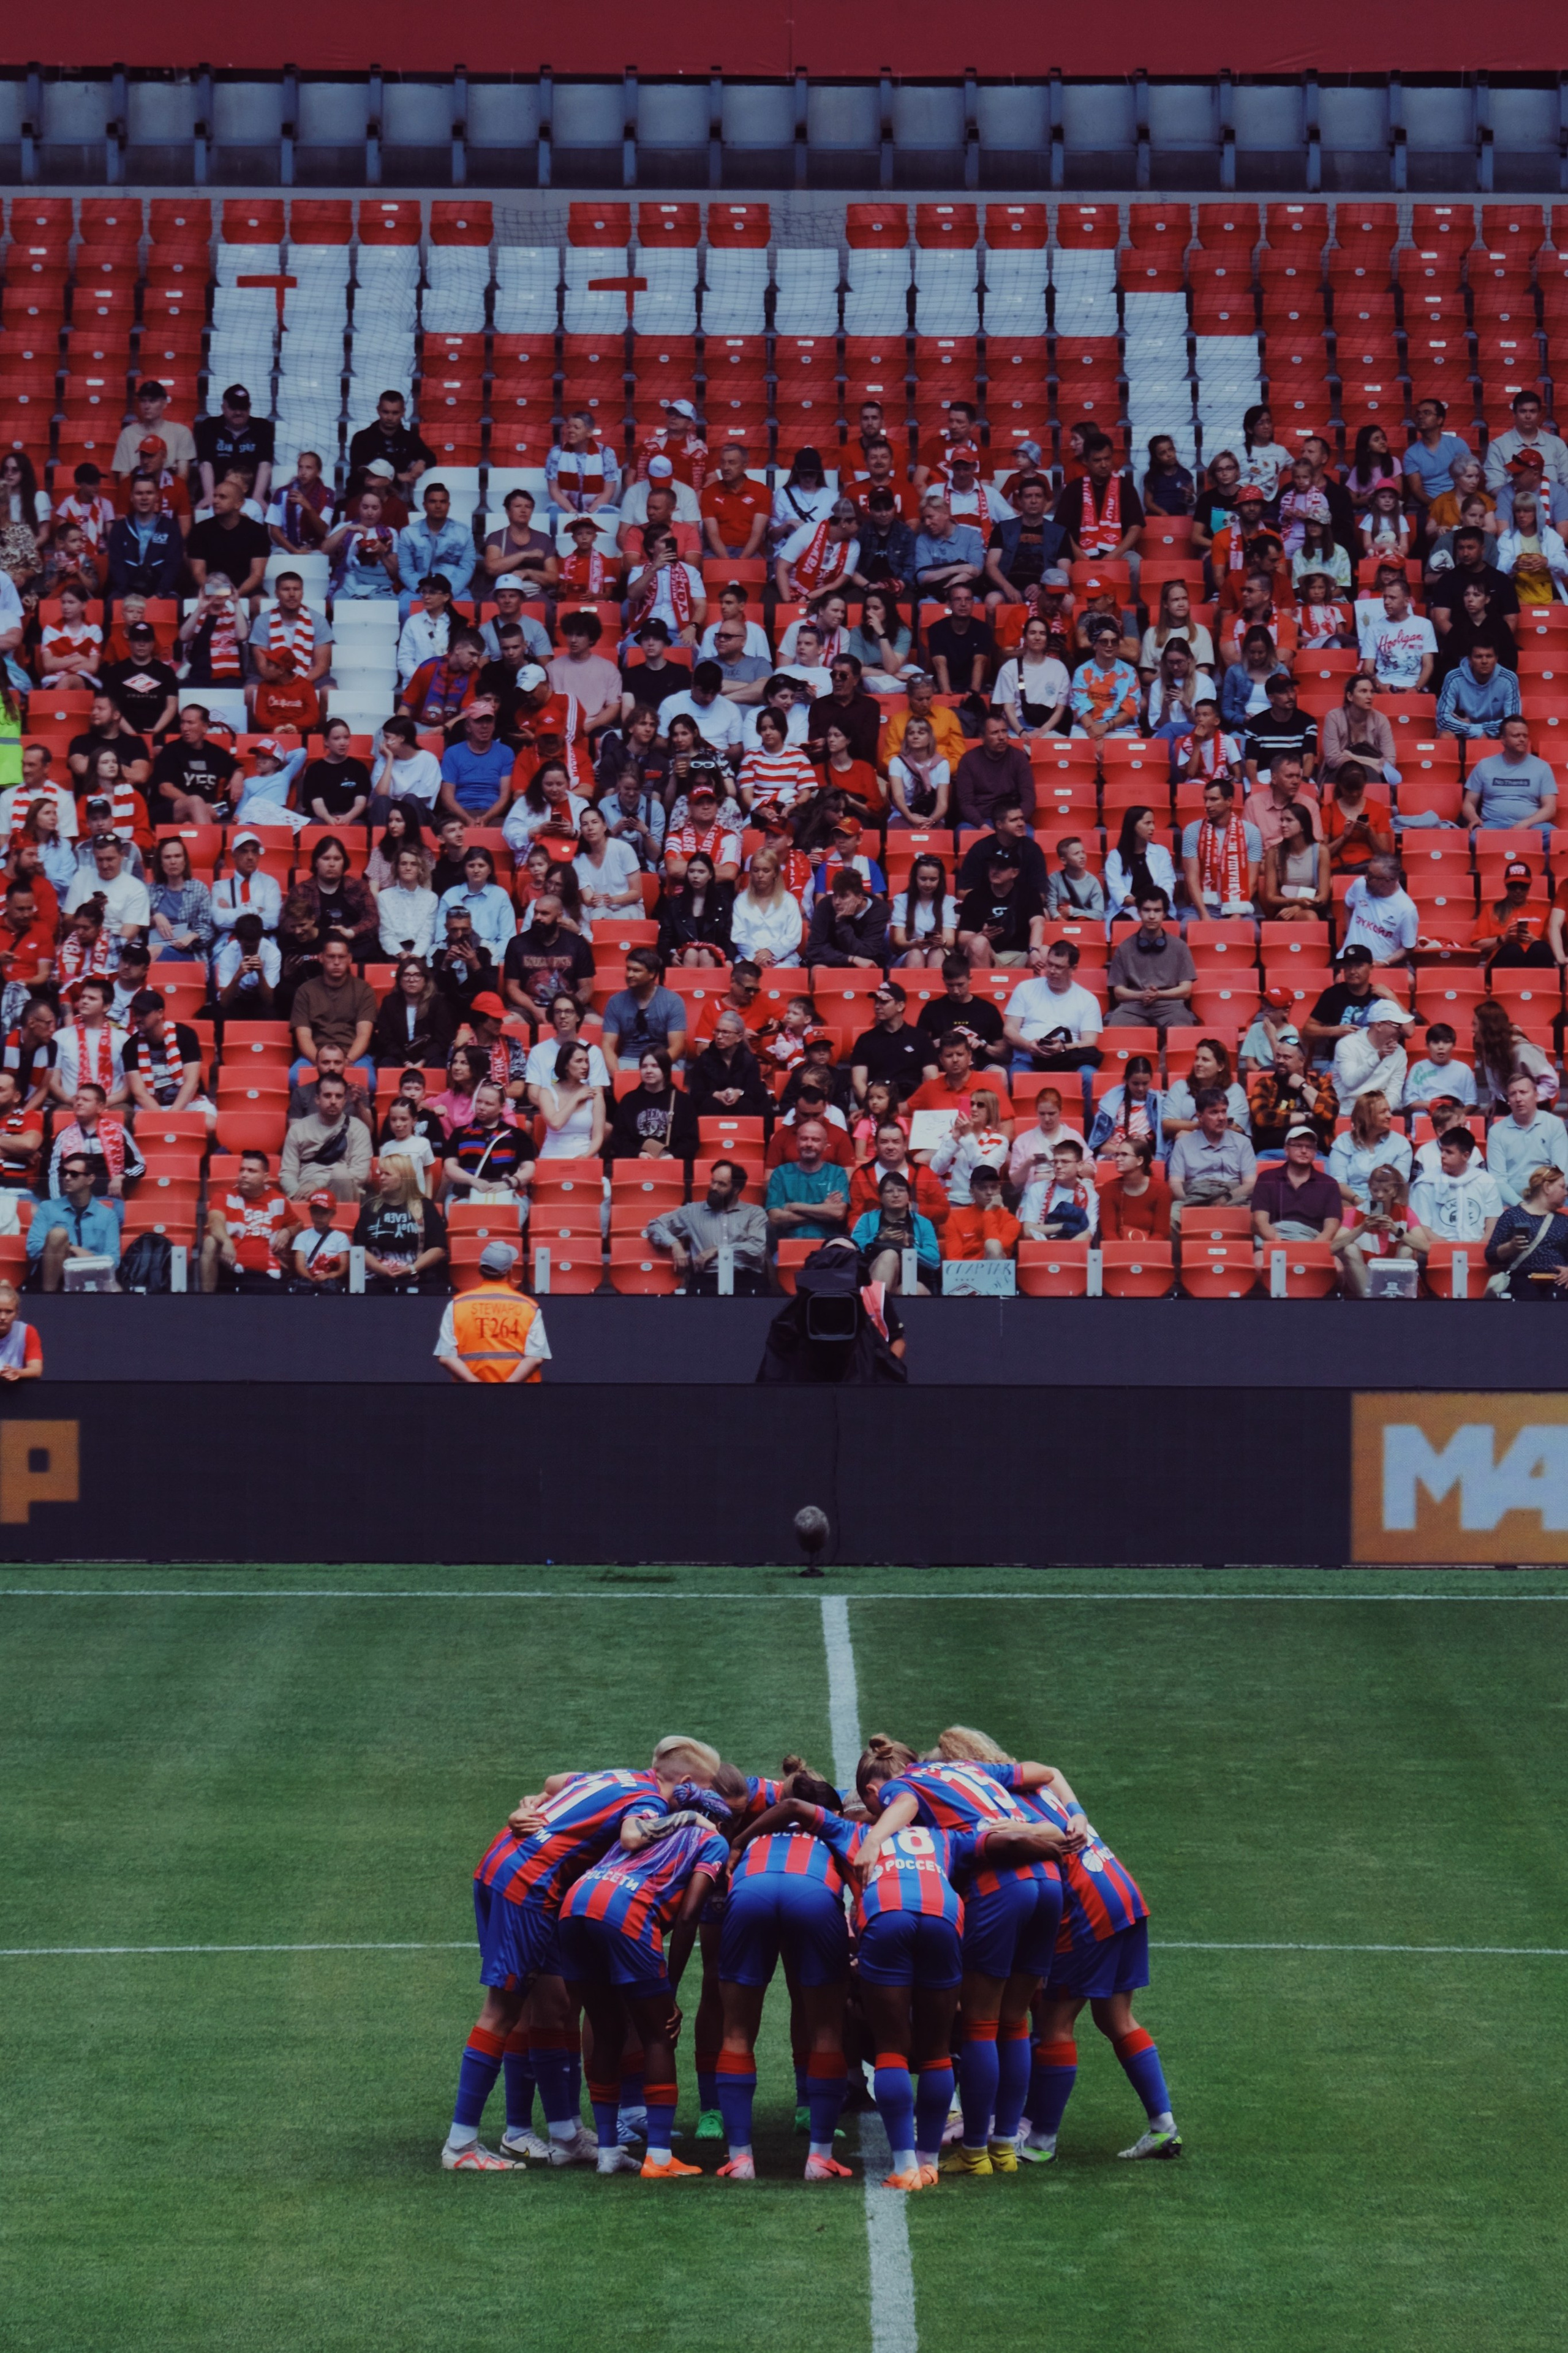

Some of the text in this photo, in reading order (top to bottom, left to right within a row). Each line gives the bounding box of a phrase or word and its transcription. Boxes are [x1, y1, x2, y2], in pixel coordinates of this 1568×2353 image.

[152, 532, 168, 542] EA7
[183, 772, 217, 790] YES
[471, 1303, 522, 1316] STEWARD
[475, 1317, 519, 1339] T264
[940, 1766, 1017, 1811] 15
